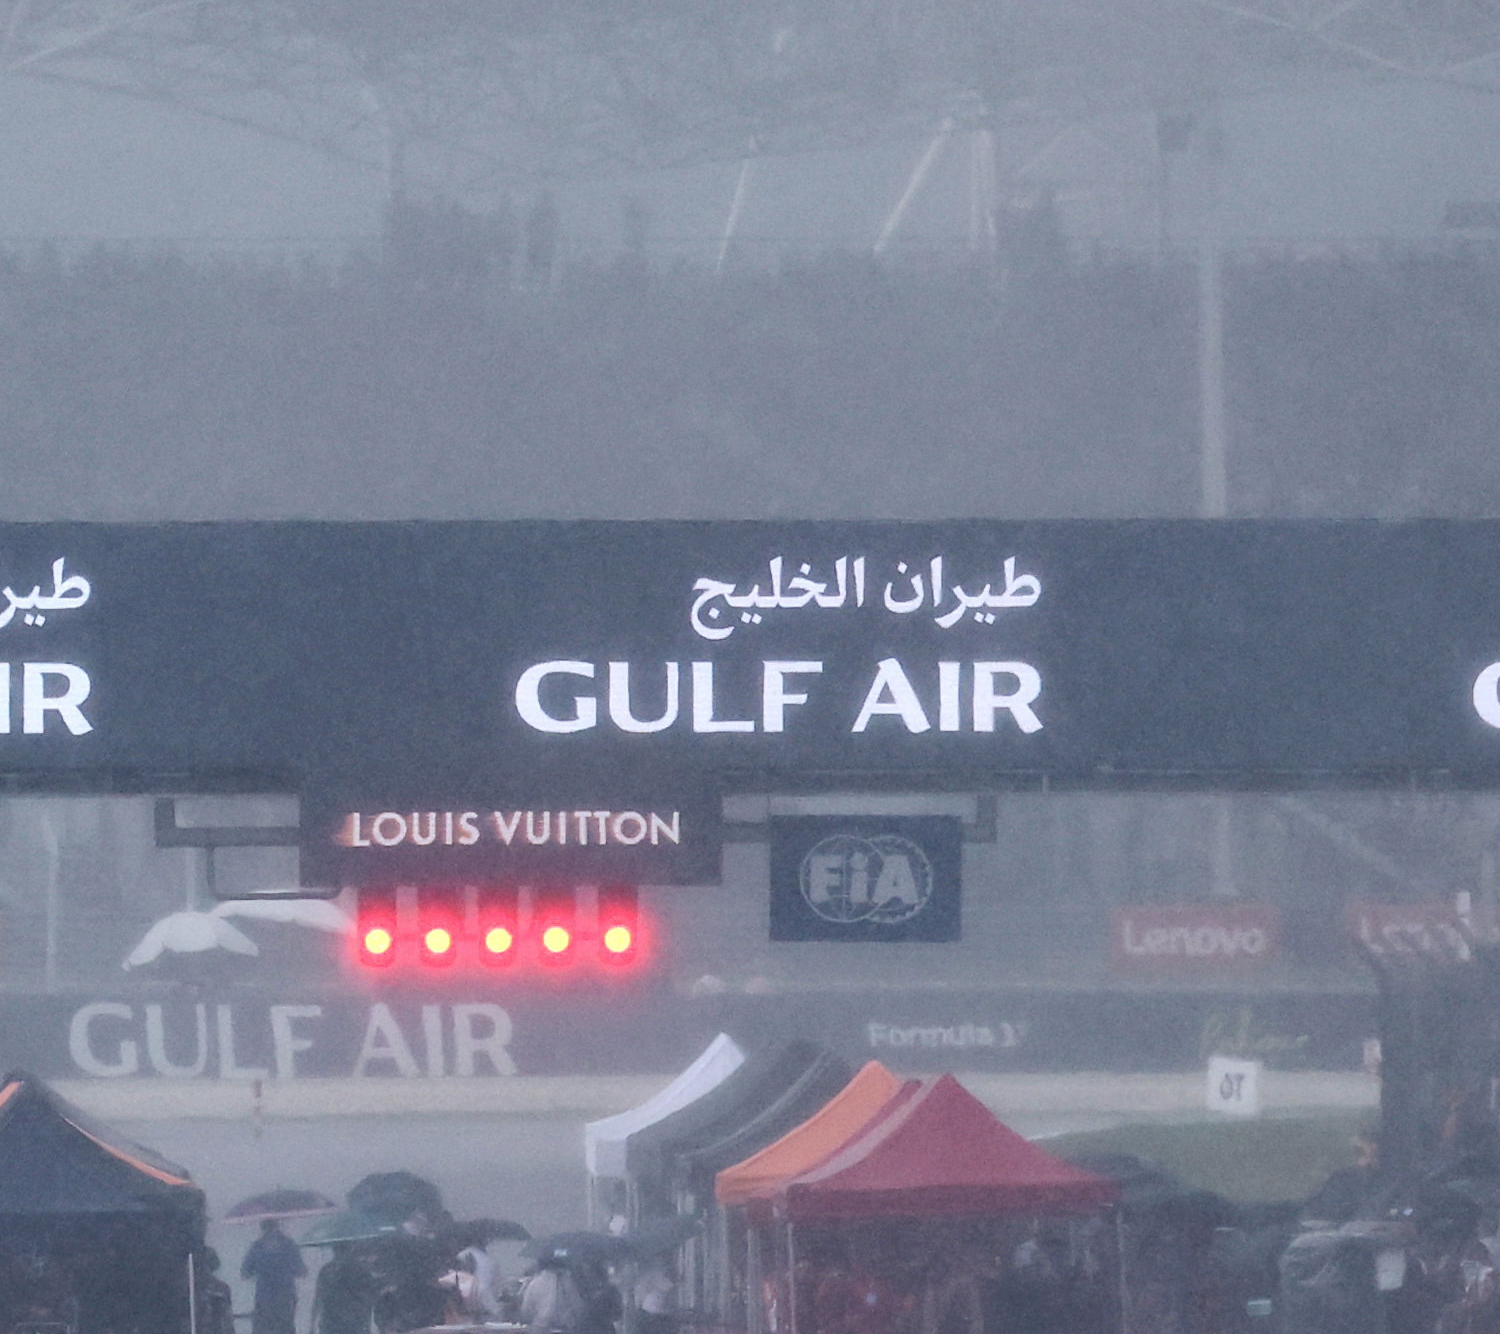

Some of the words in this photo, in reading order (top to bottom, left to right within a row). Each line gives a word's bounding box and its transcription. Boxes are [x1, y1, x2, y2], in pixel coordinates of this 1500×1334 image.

[690, 556, 866, 640] الخليج
[883, 555, 1042, 629] طيران
[515, 659, 823, 733] GULF
[851, 657, 1044, 733] AIR
[351, 811, 480, 847] LOUIS
[494, 811, 680, 846] VUITTON
[1122, 919, 1267, 957] Lenovo
[69, 1002, 323, 1080] GULF
[358, 1001, 518, 1079] AIR
